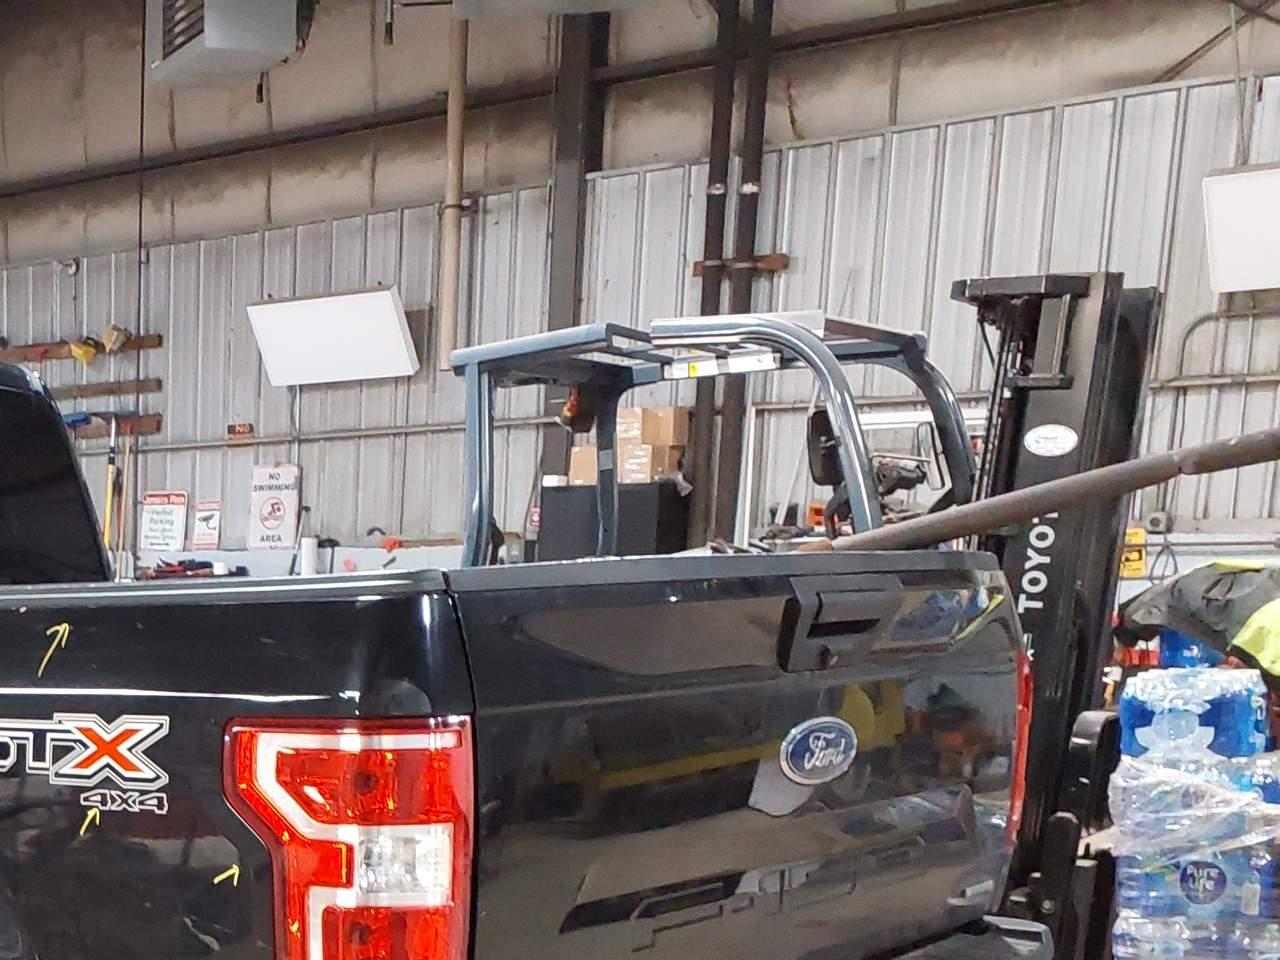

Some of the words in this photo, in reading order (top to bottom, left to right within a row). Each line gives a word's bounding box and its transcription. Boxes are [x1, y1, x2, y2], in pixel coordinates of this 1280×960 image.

[269, 473, 281, 481] NO
[254, 484, 298, 492] SWIMMING
[260, 534, 282, 543] AREA
[1017, 511, 1060, 614] TOYO
